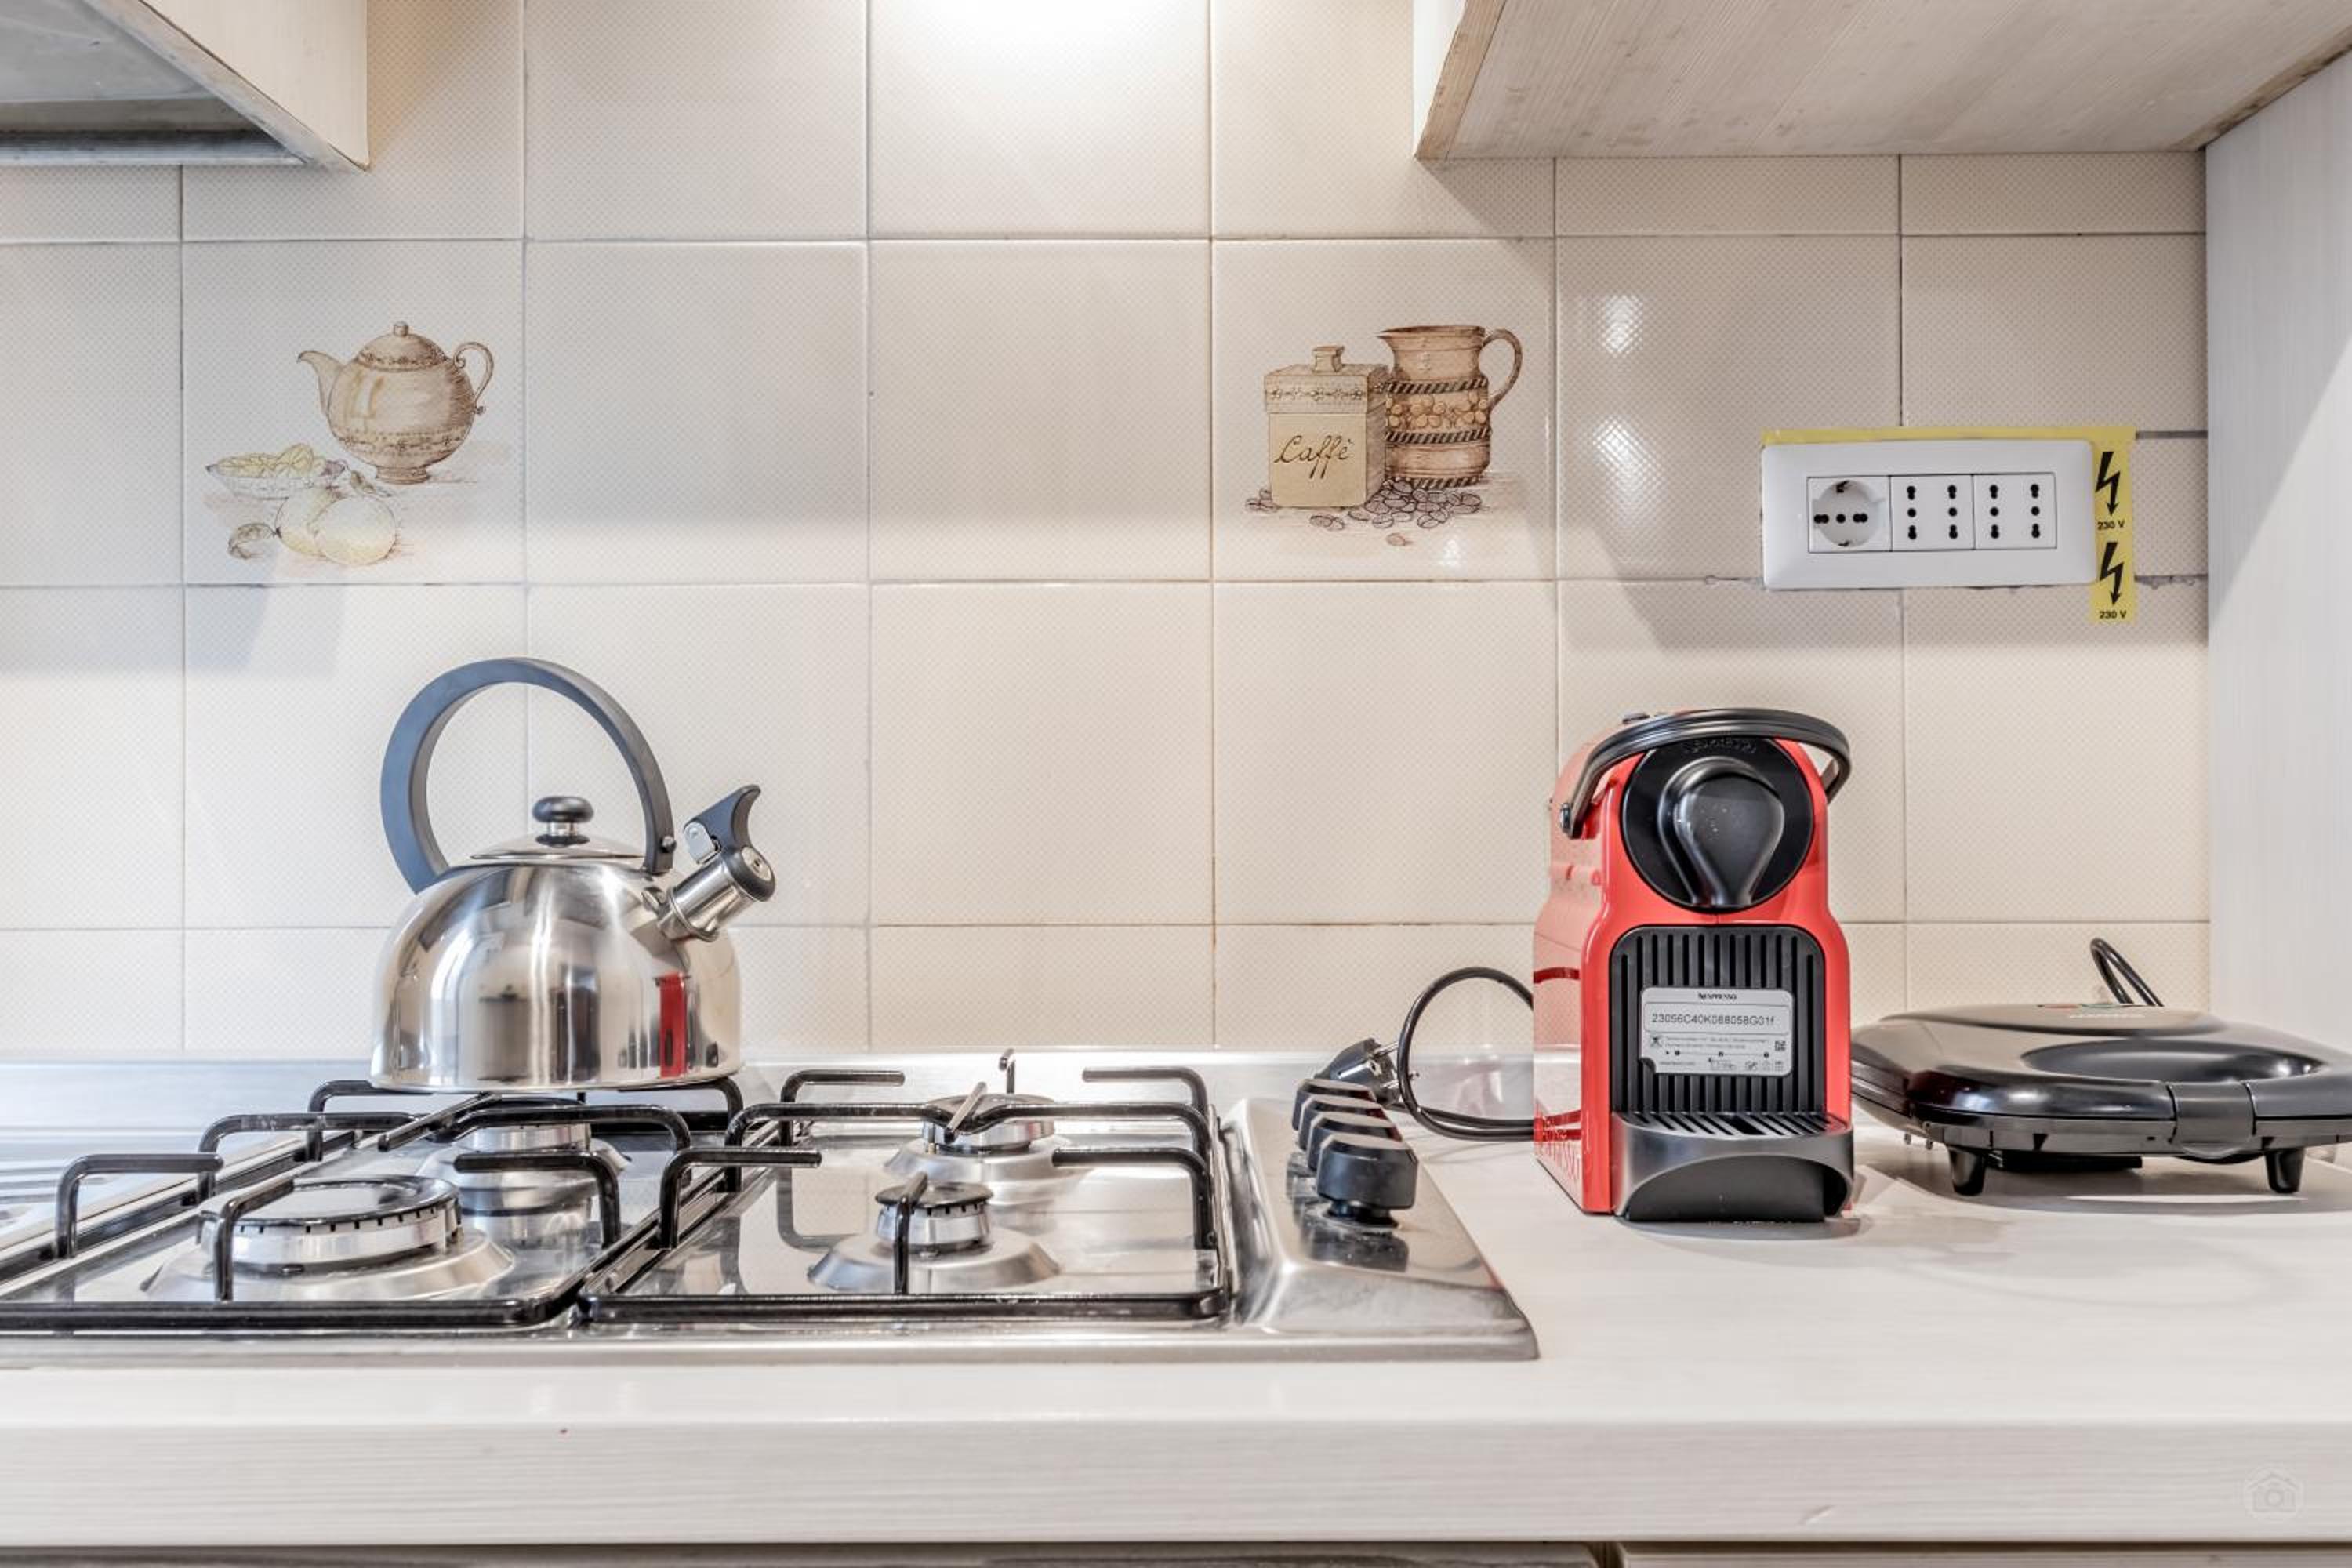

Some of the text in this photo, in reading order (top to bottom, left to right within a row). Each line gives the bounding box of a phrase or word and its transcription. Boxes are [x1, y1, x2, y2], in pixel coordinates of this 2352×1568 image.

[1273, 435, 1354, 479] Caffè
[2097, 520, 2125, 530] 230 V
[2100, 609, 2127, 619] 230 V
